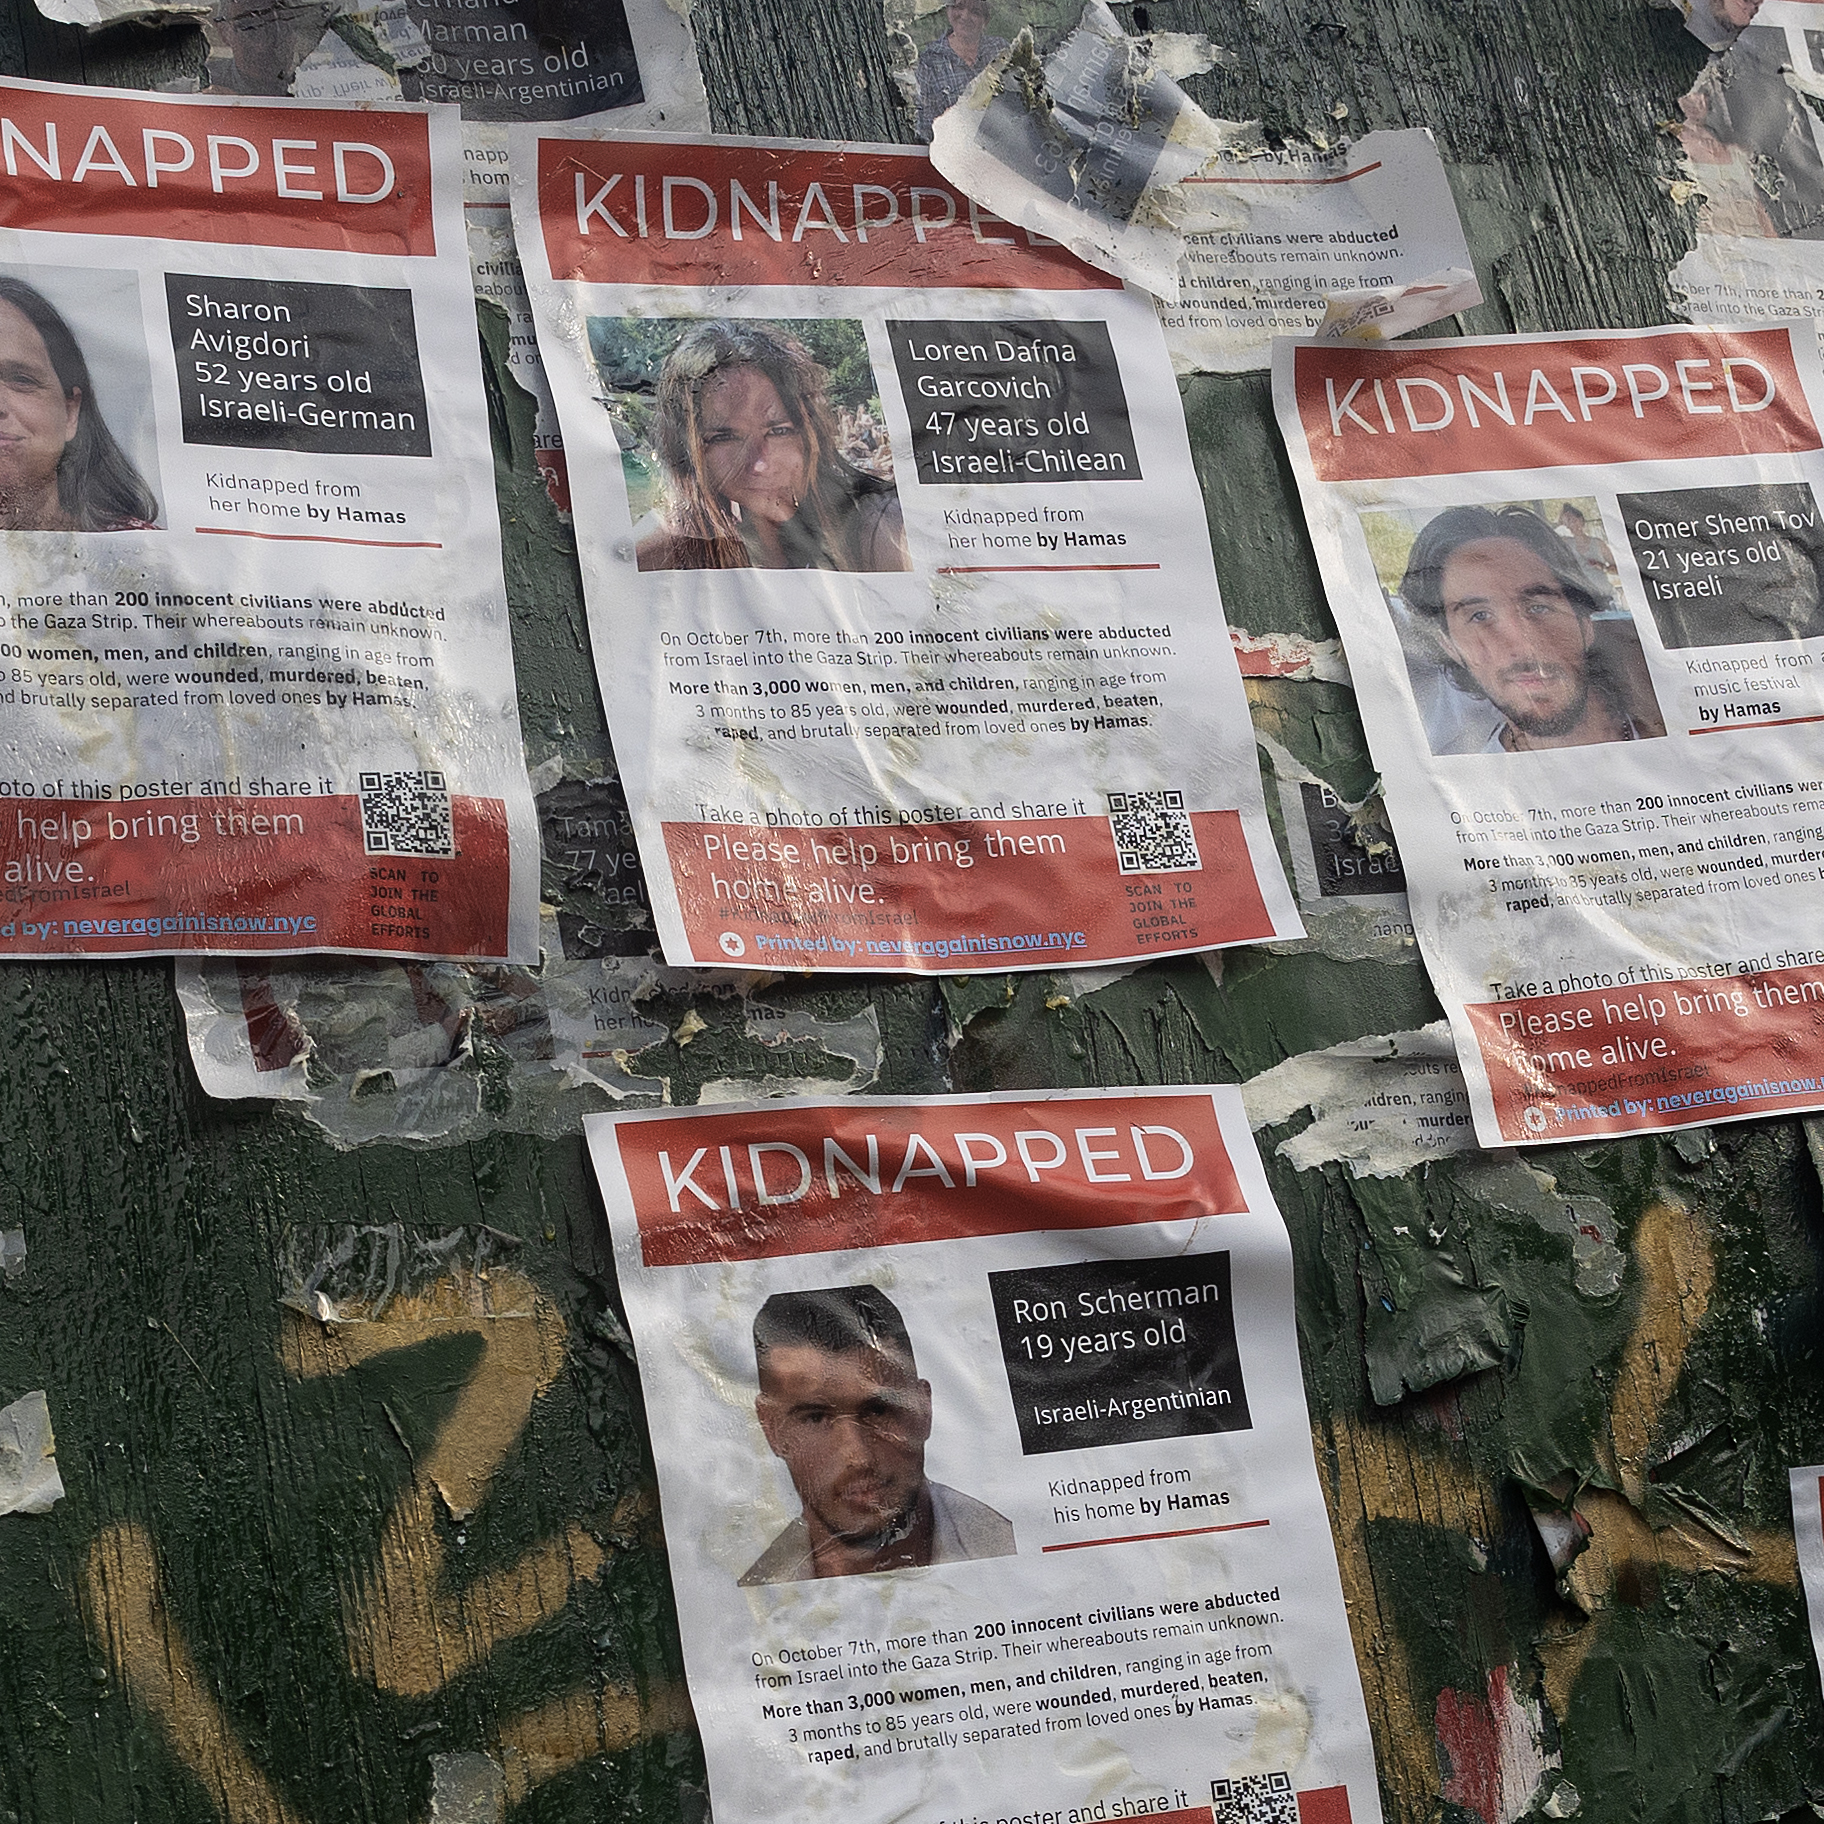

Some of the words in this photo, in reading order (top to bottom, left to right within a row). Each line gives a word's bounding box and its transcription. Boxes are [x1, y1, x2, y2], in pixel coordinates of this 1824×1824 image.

[457, 55, 534, 80] years
[544, 41, 591, 71] old
[420, 69, 626, 105] Israeli-Argentinian
[1219, 233, 1282, 246] civilians
[1286, 233, 1324, 244] were
[1328, 224, 1399, 245] abducted
[1190, 276, 1255, 291] children,
[185, 294, 292, 322] Sharon
[192, 330, 310, 362] Avigdori
[909, 339, 988, 362] Loren
[996, 339, 1076, 364] Dafna
[918, 373, 1051, 400] Garcovich
[1325, 357, 1775, 437] KIDNAPPED
[199, 395, 415, 431] Israeli-German
[932, 444, 1126, 475] Israeli-Chilean
[1636, 517, 1701, 543] Omer
[1707, 513, 1771, 537] Shem
[1774, 508, 1815, 532] Tov
[1654, 575, 1723, 600] Israeli
[657, 1123, 1193, 1212] KIDNAPPED
[1012, 1297, 1068, 1323] Ron
[1076, 1278, 1220, 1314] Scherman
[1034, 1388, 1231, 1427] Israeli-Argentinian
